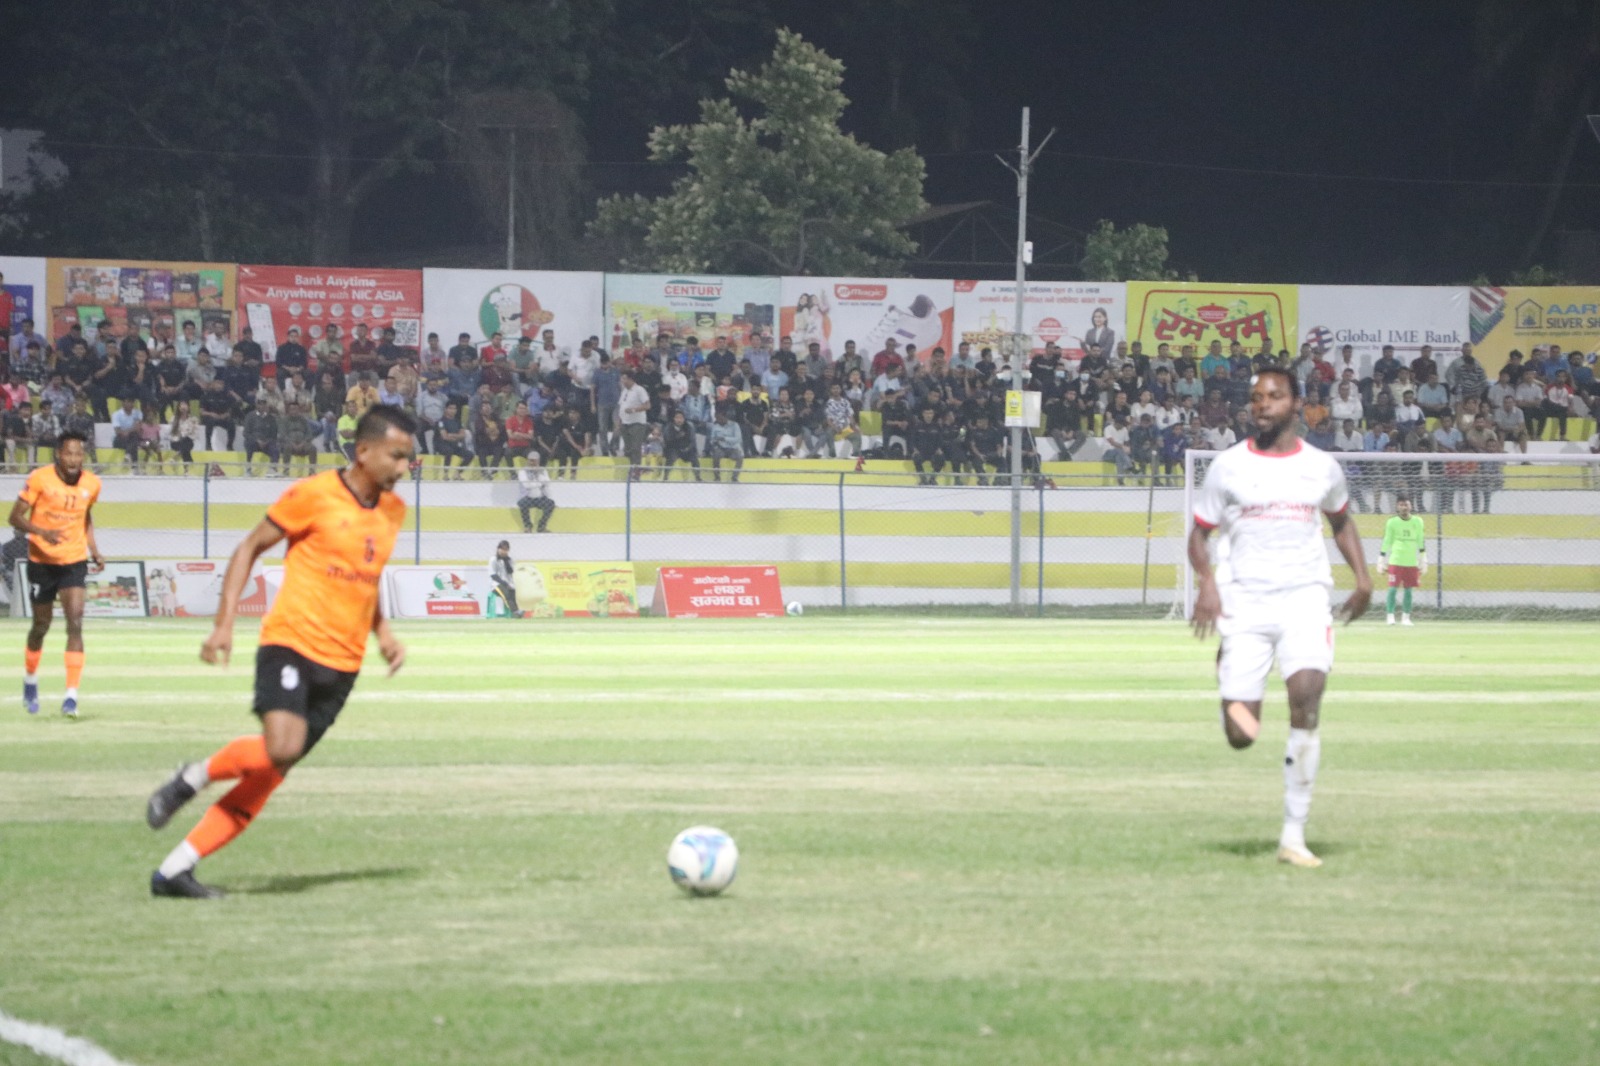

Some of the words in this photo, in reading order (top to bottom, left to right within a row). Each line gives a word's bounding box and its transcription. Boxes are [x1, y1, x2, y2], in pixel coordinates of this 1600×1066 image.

[294, 274, 323, 286] Bank
[326, 275, 377, 289] Anytime
[266, 287, 327, 300] Anywhere
[329, 291, 348, 299] with
[351, 290, 373, 300] NIC
[374, 290, 405, 301] ASIA
[664, 285, 722, 296] CENTURY
[1546, 317, 1583, 329] SILVER
[1335, 329, 1382, 343] Global
[1388, 331, 1419, 343] IME
[1424, 331, 1462, 344] Bank
